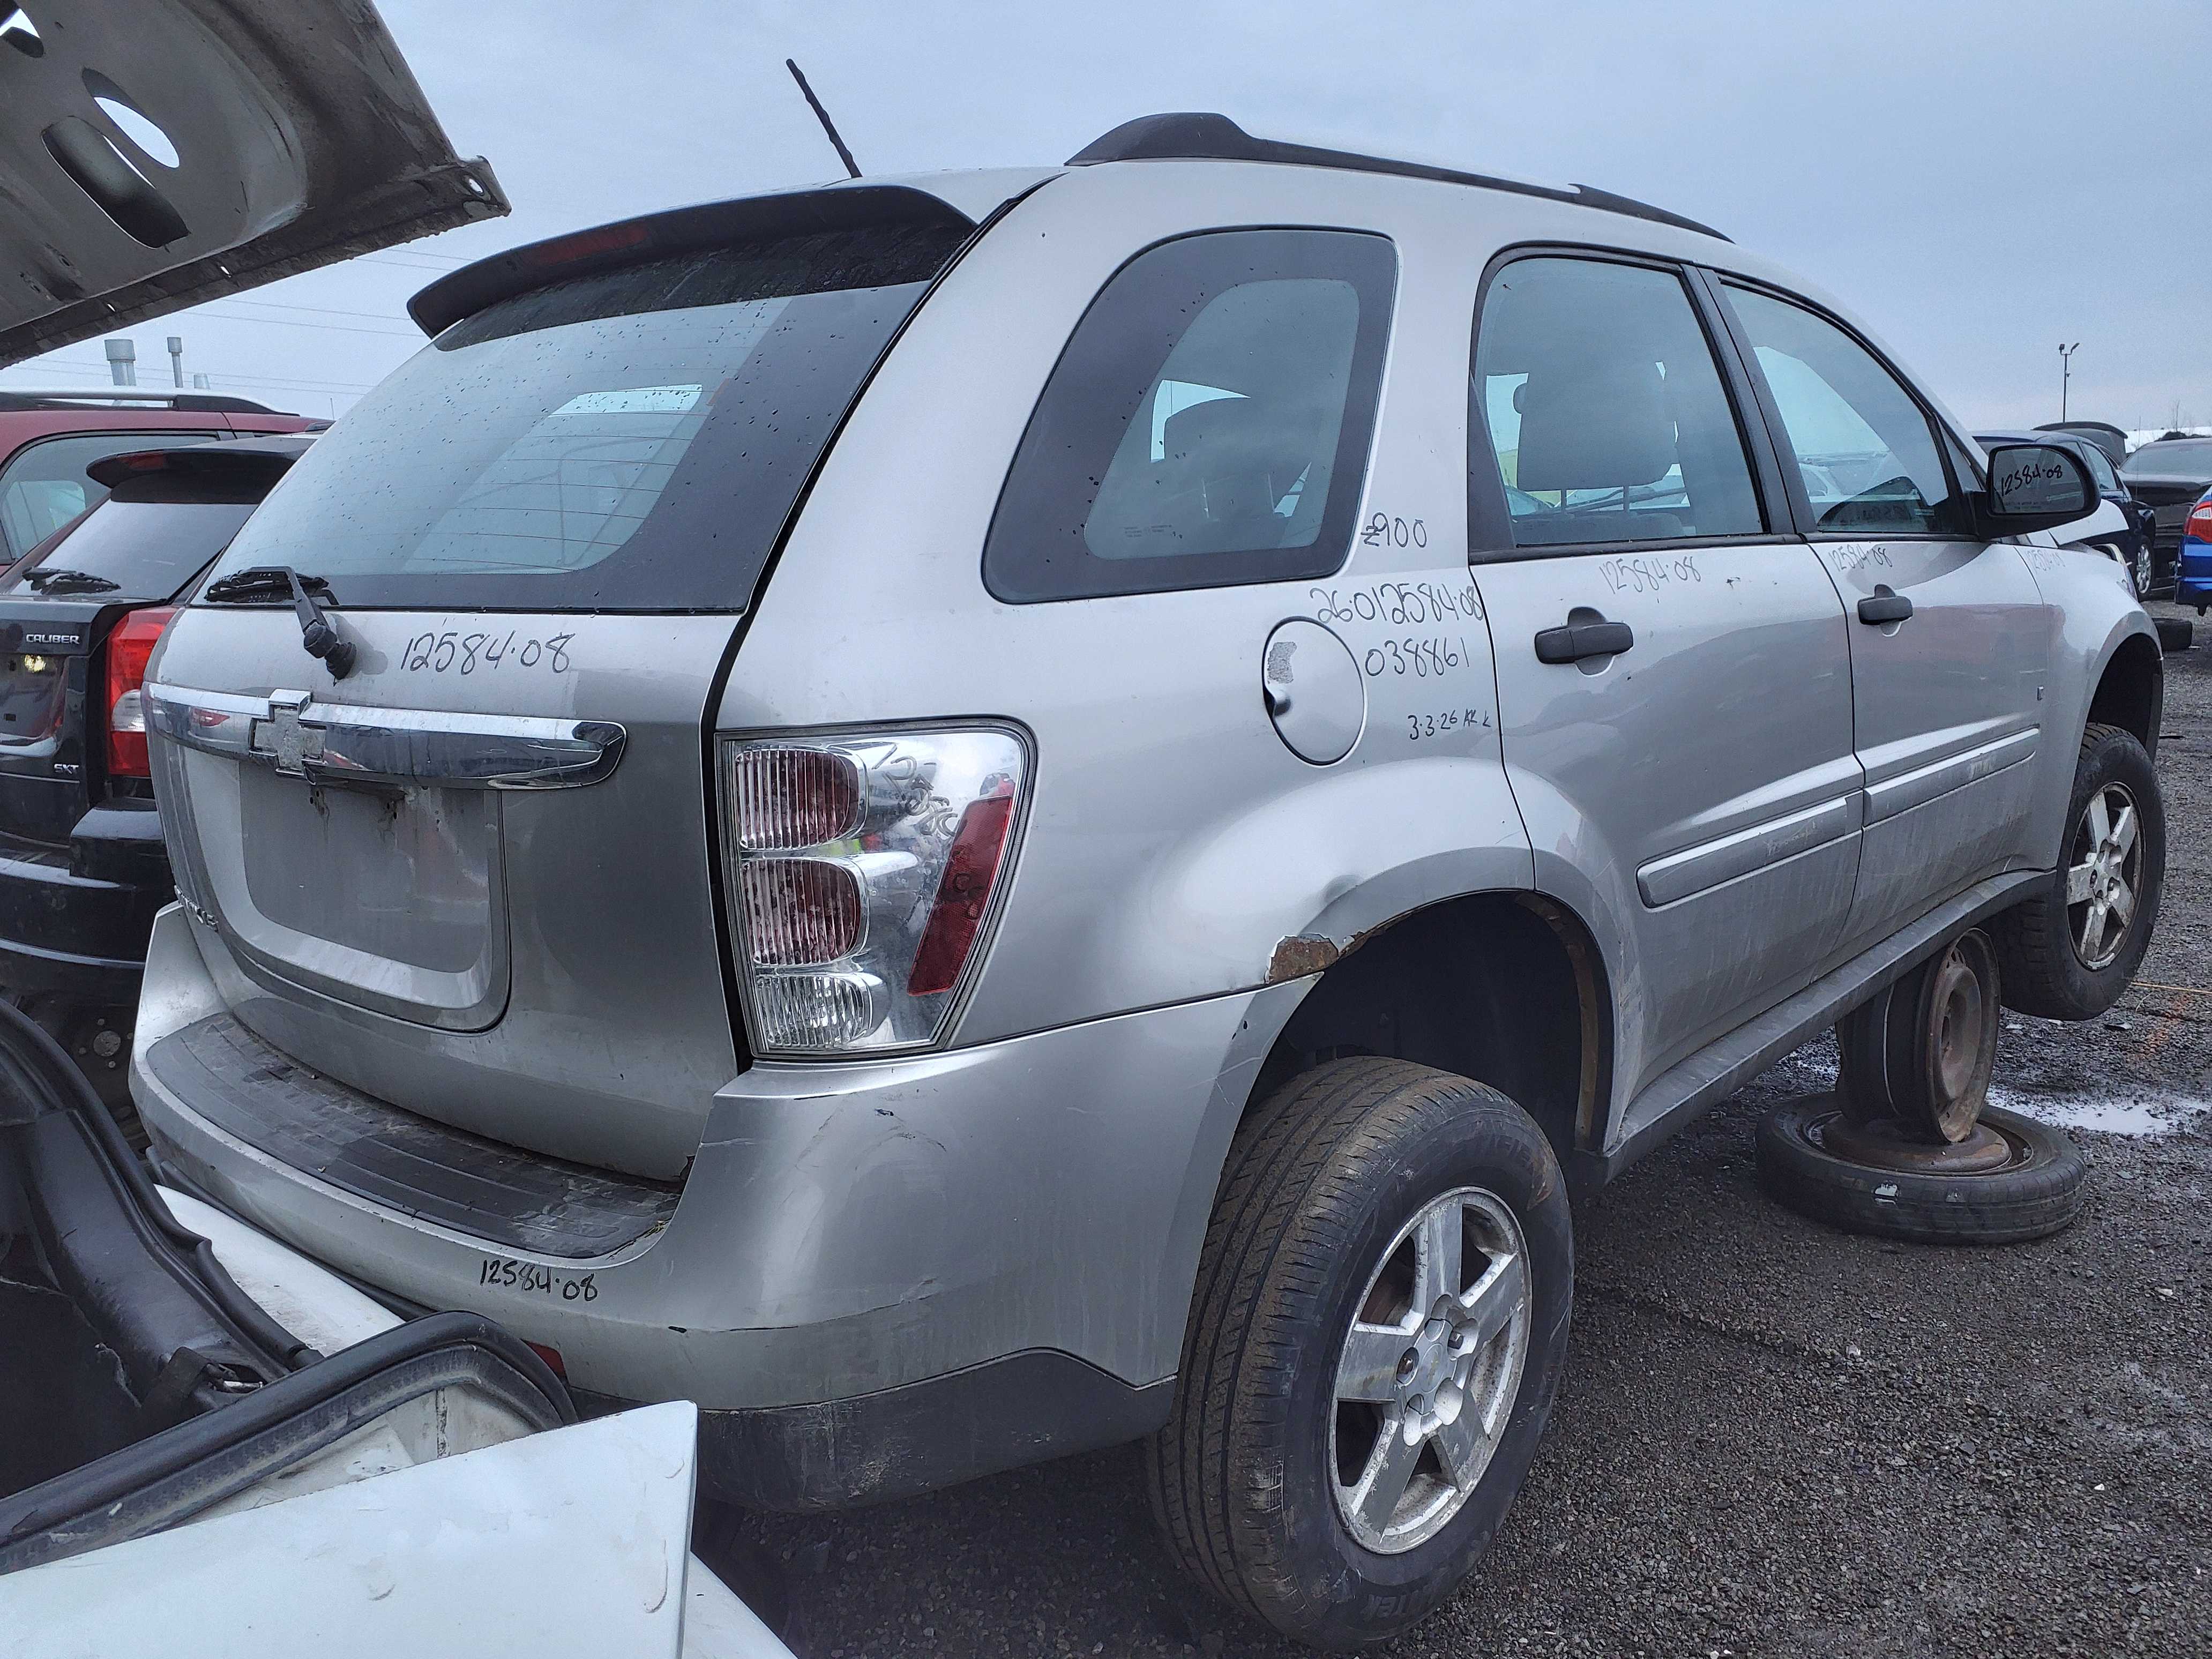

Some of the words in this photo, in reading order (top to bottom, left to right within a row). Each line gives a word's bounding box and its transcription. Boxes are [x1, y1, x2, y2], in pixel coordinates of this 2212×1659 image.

[26, 634, 80, 645] CALIBER
[1365, 637, 1469, 677] 038861
[54, 763, 79, 775] SXT
